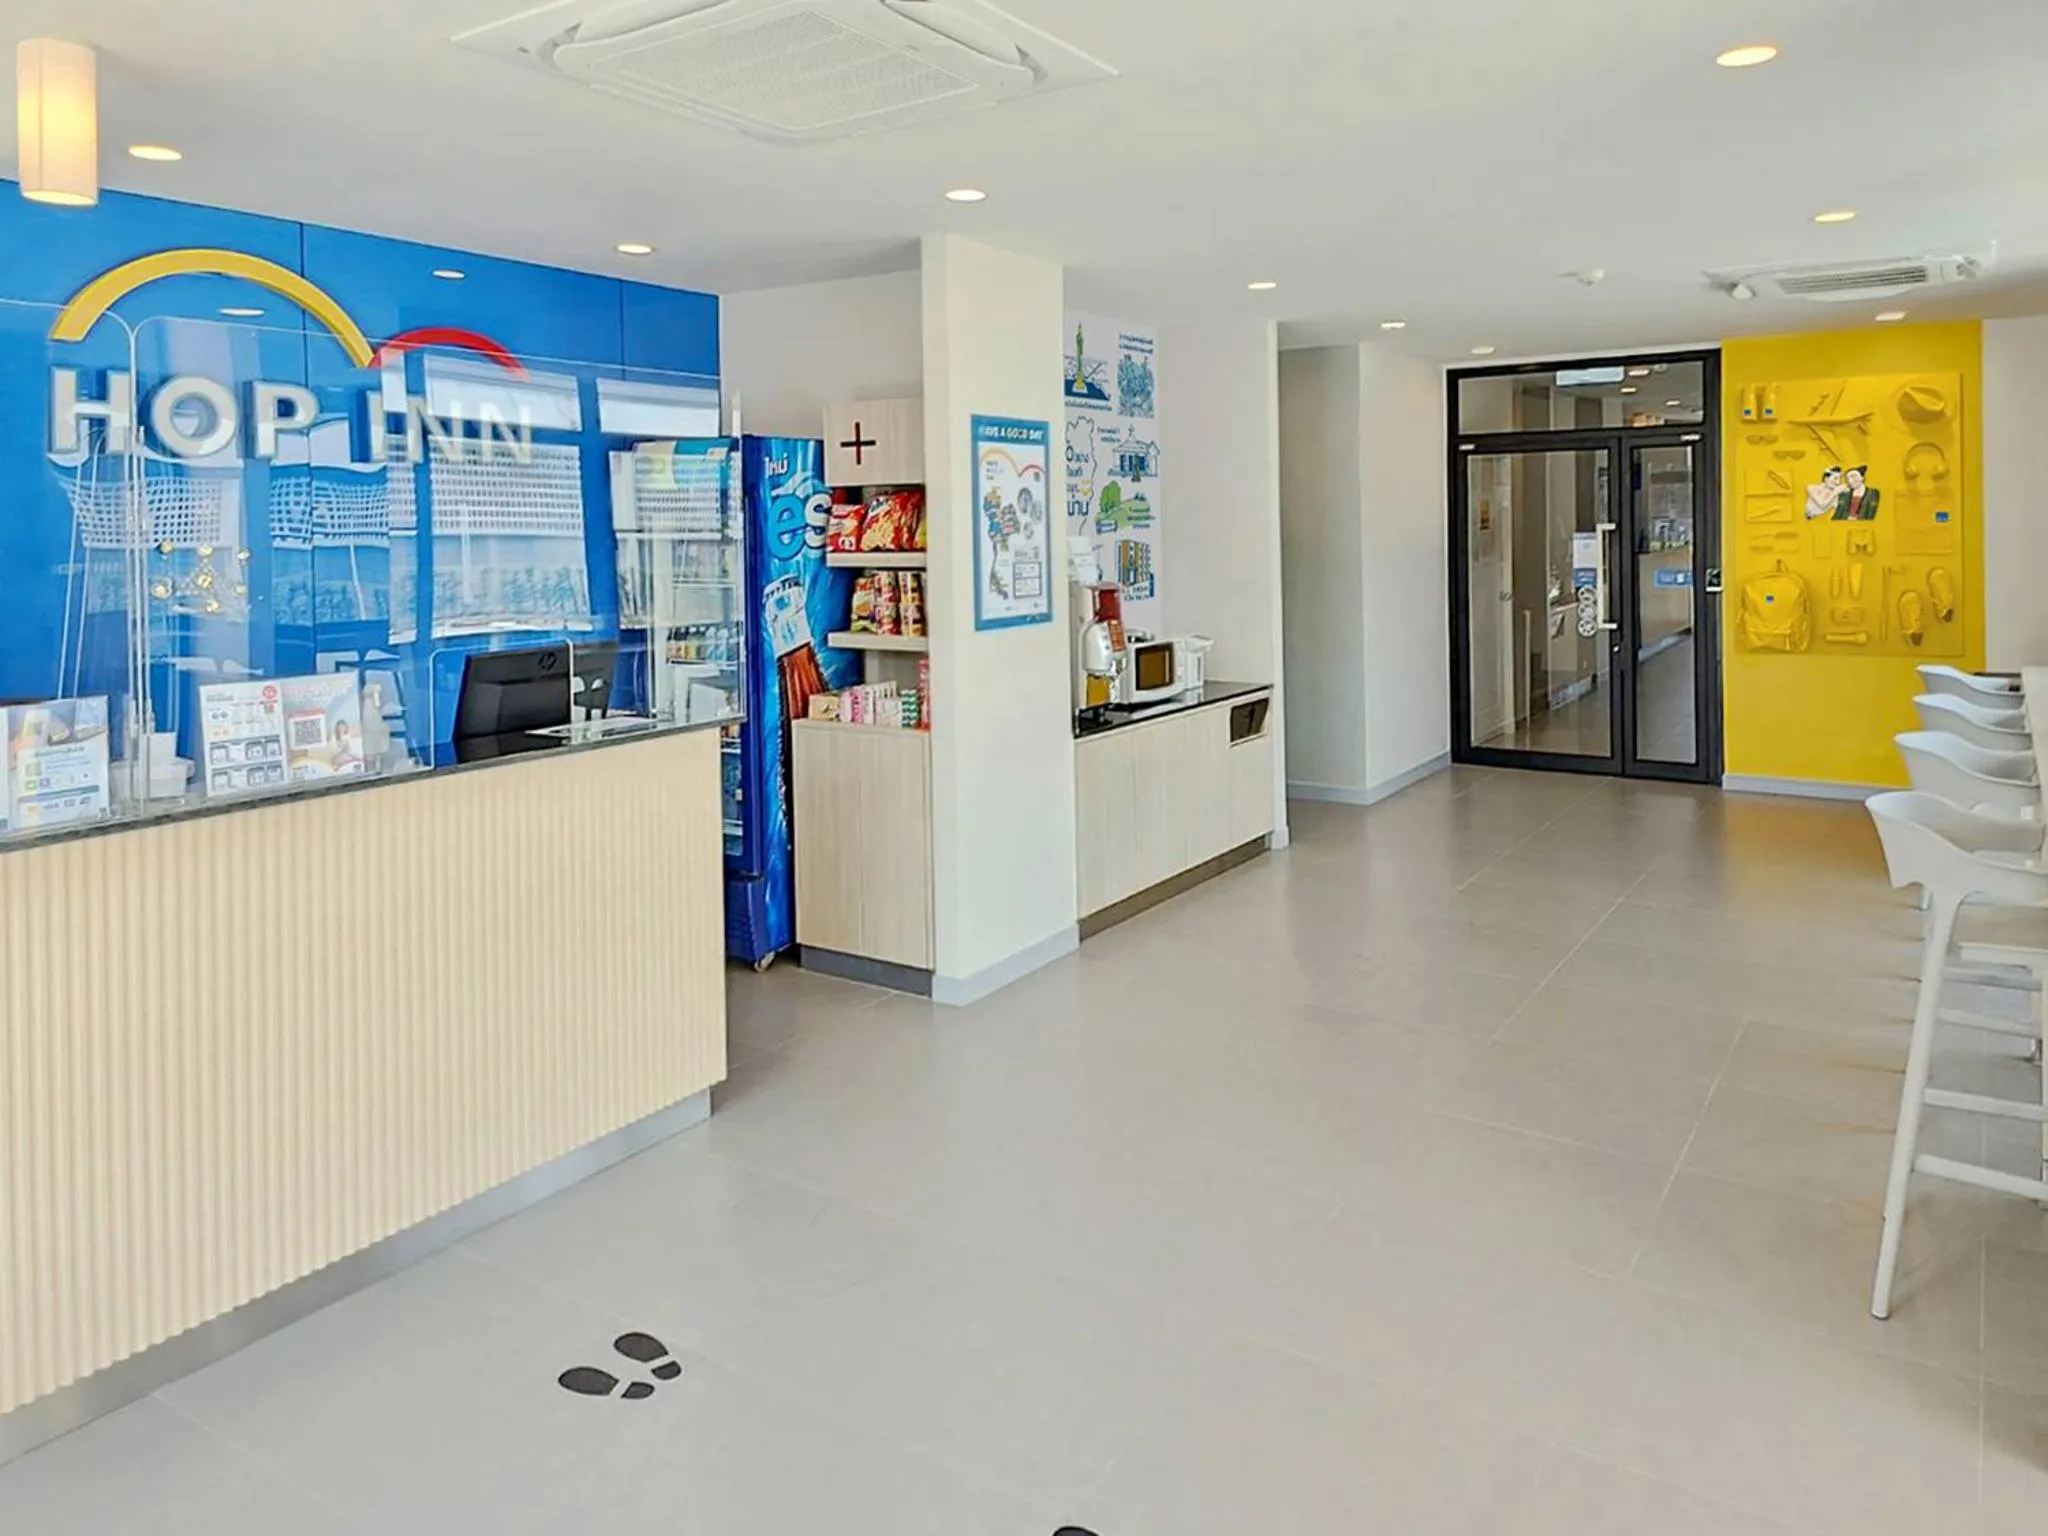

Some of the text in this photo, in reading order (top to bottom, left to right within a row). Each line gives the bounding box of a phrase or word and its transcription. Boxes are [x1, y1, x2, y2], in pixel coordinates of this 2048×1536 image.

[51, 365, 534, 464] HOP INN
[767, 492, 833, 562] es
